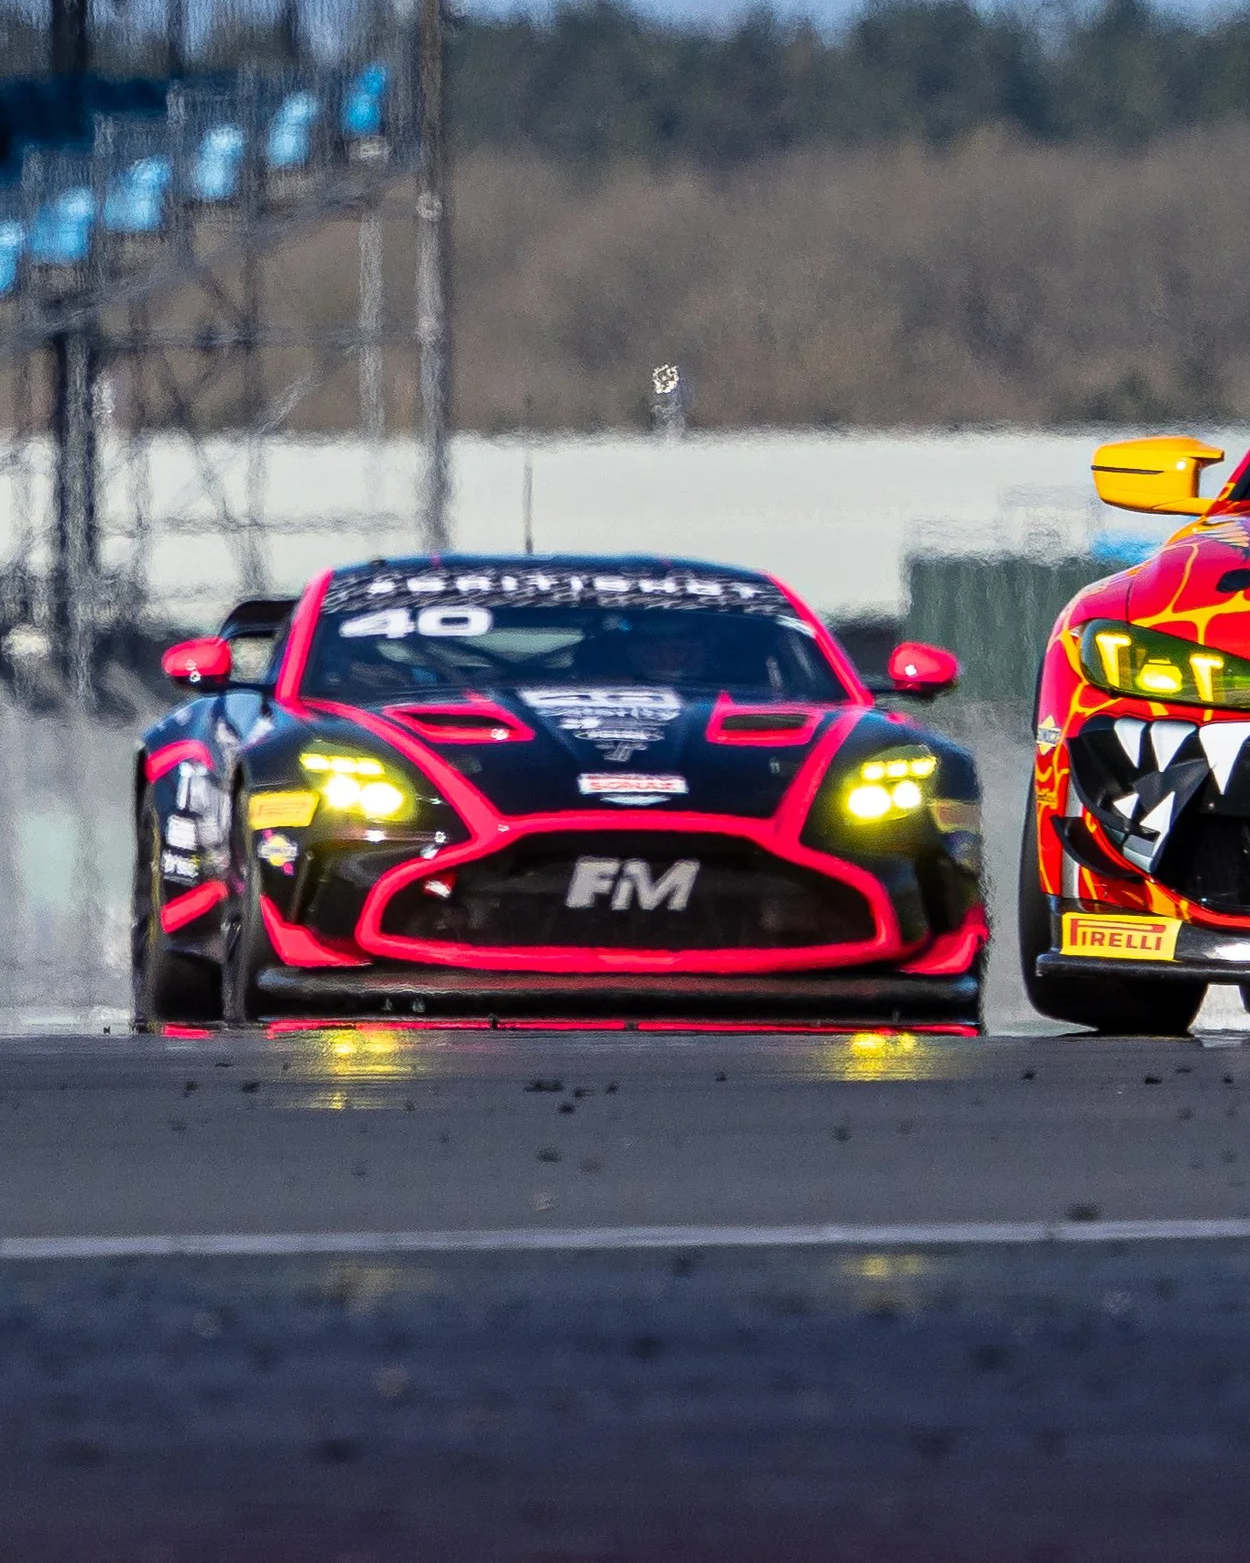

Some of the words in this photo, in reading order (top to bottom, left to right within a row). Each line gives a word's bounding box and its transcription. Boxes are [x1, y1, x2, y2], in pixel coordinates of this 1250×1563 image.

[338, 606, 494, 638] 40
[565, 855, 701, 911] FM
[1070, 917, 1167, 951] PIRELLI
